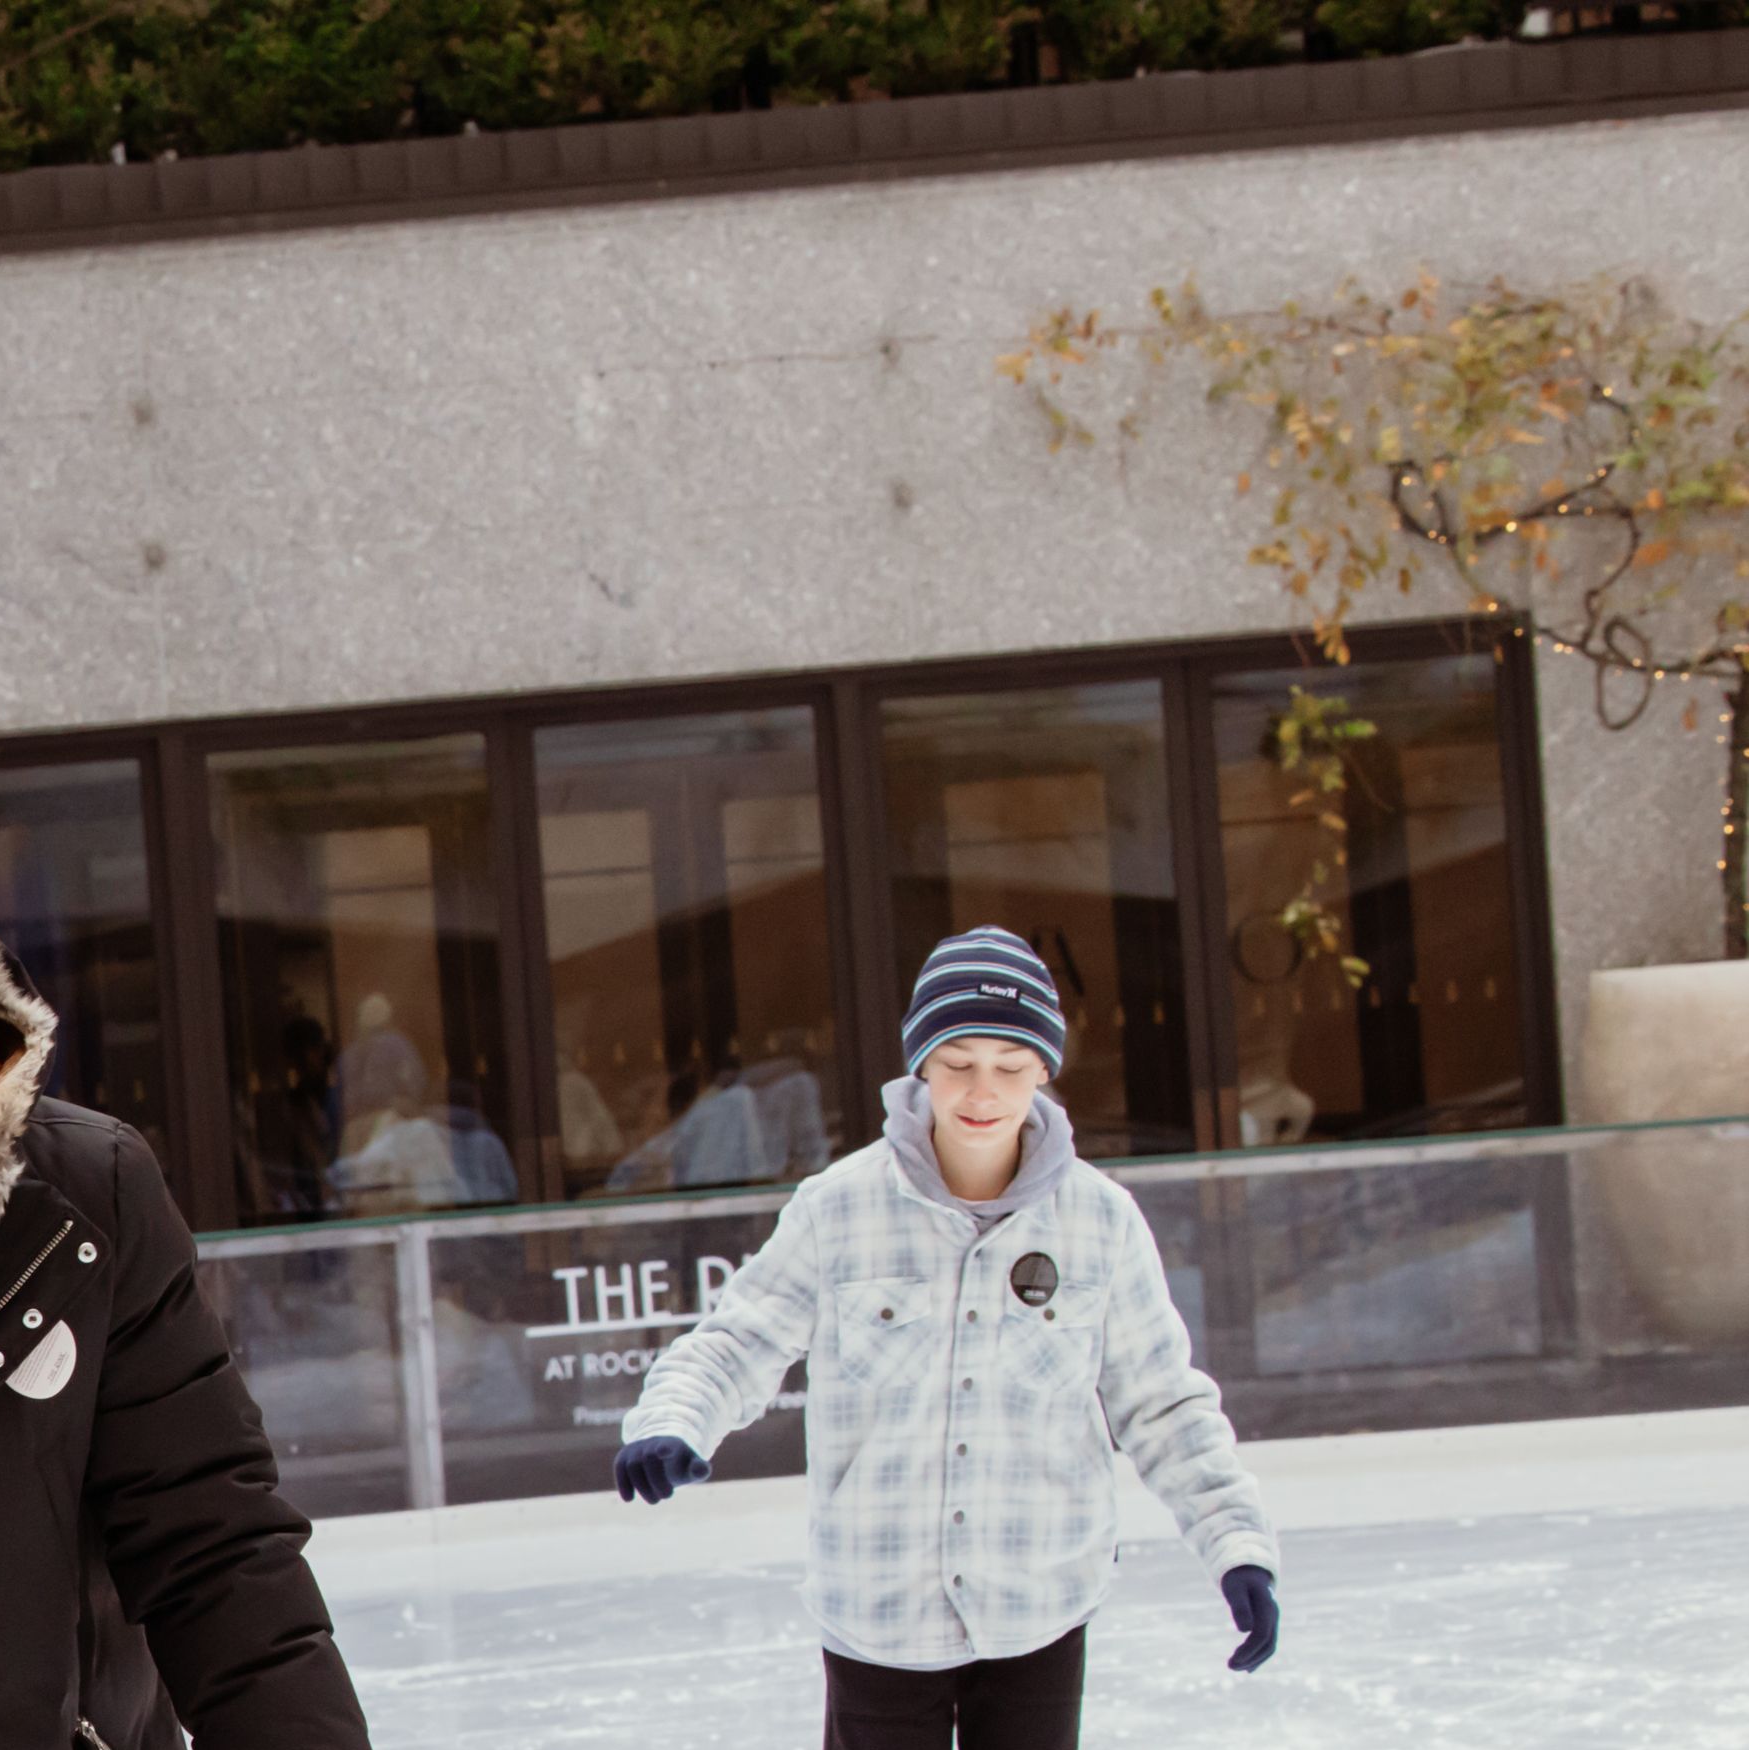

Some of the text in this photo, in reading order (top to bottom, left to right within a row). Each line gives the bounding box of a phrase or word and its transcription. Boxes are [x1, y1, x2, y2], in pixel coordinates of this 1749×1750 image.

[552, 1259, 673, 1327] THE
[544, 1347, 670, 1382] AT ROCK
